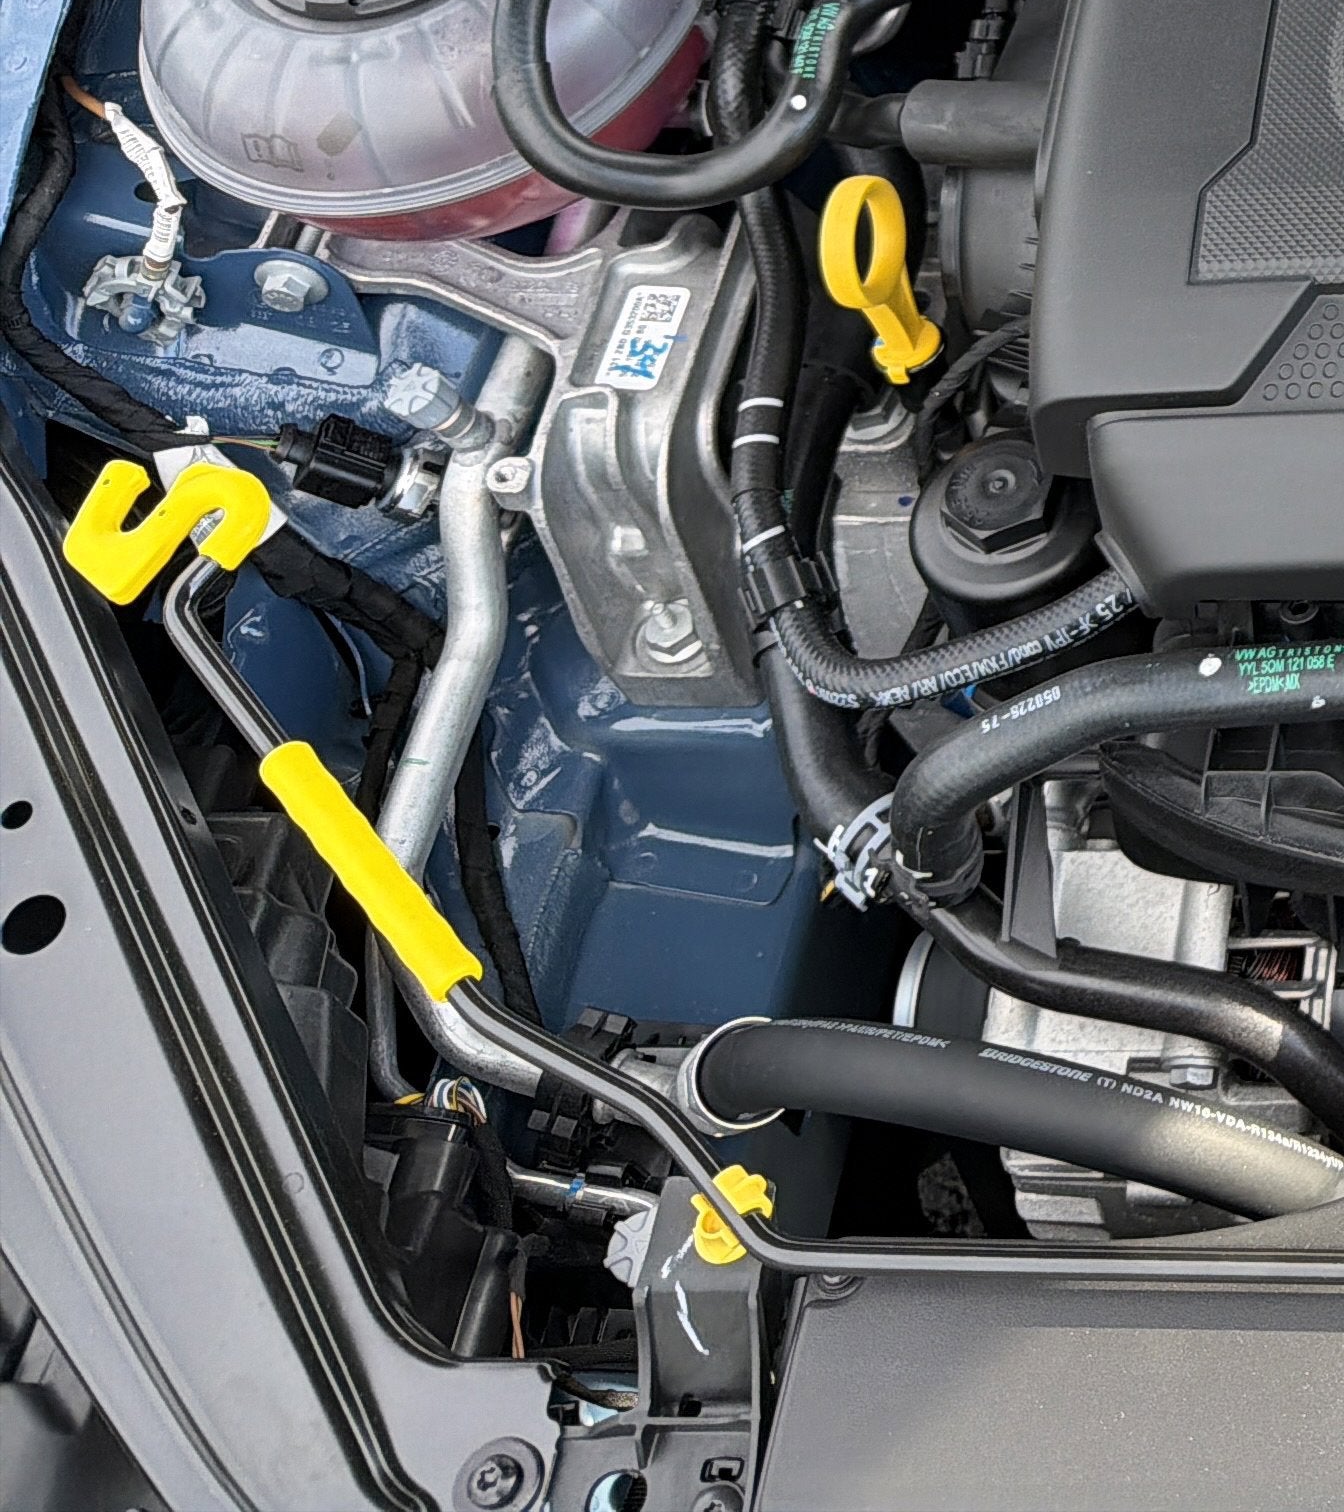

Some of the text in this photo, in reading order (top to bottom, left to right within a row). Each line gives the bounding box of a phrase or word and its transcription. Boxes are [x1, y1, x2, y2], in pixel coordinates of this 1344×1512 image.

[1096, 594, 1125, 621] 25
[1235, 648, 1257, 661] VW
[1258, 646, 1276, 659] AG
[1287, 656, 1304, 671] 121
[978, 1046, 1093, 1083] BRIDGESTONE
[1096, 1075, 1118, 1090] (T)
[1121, 1082, 1164, 1105] ND2A
